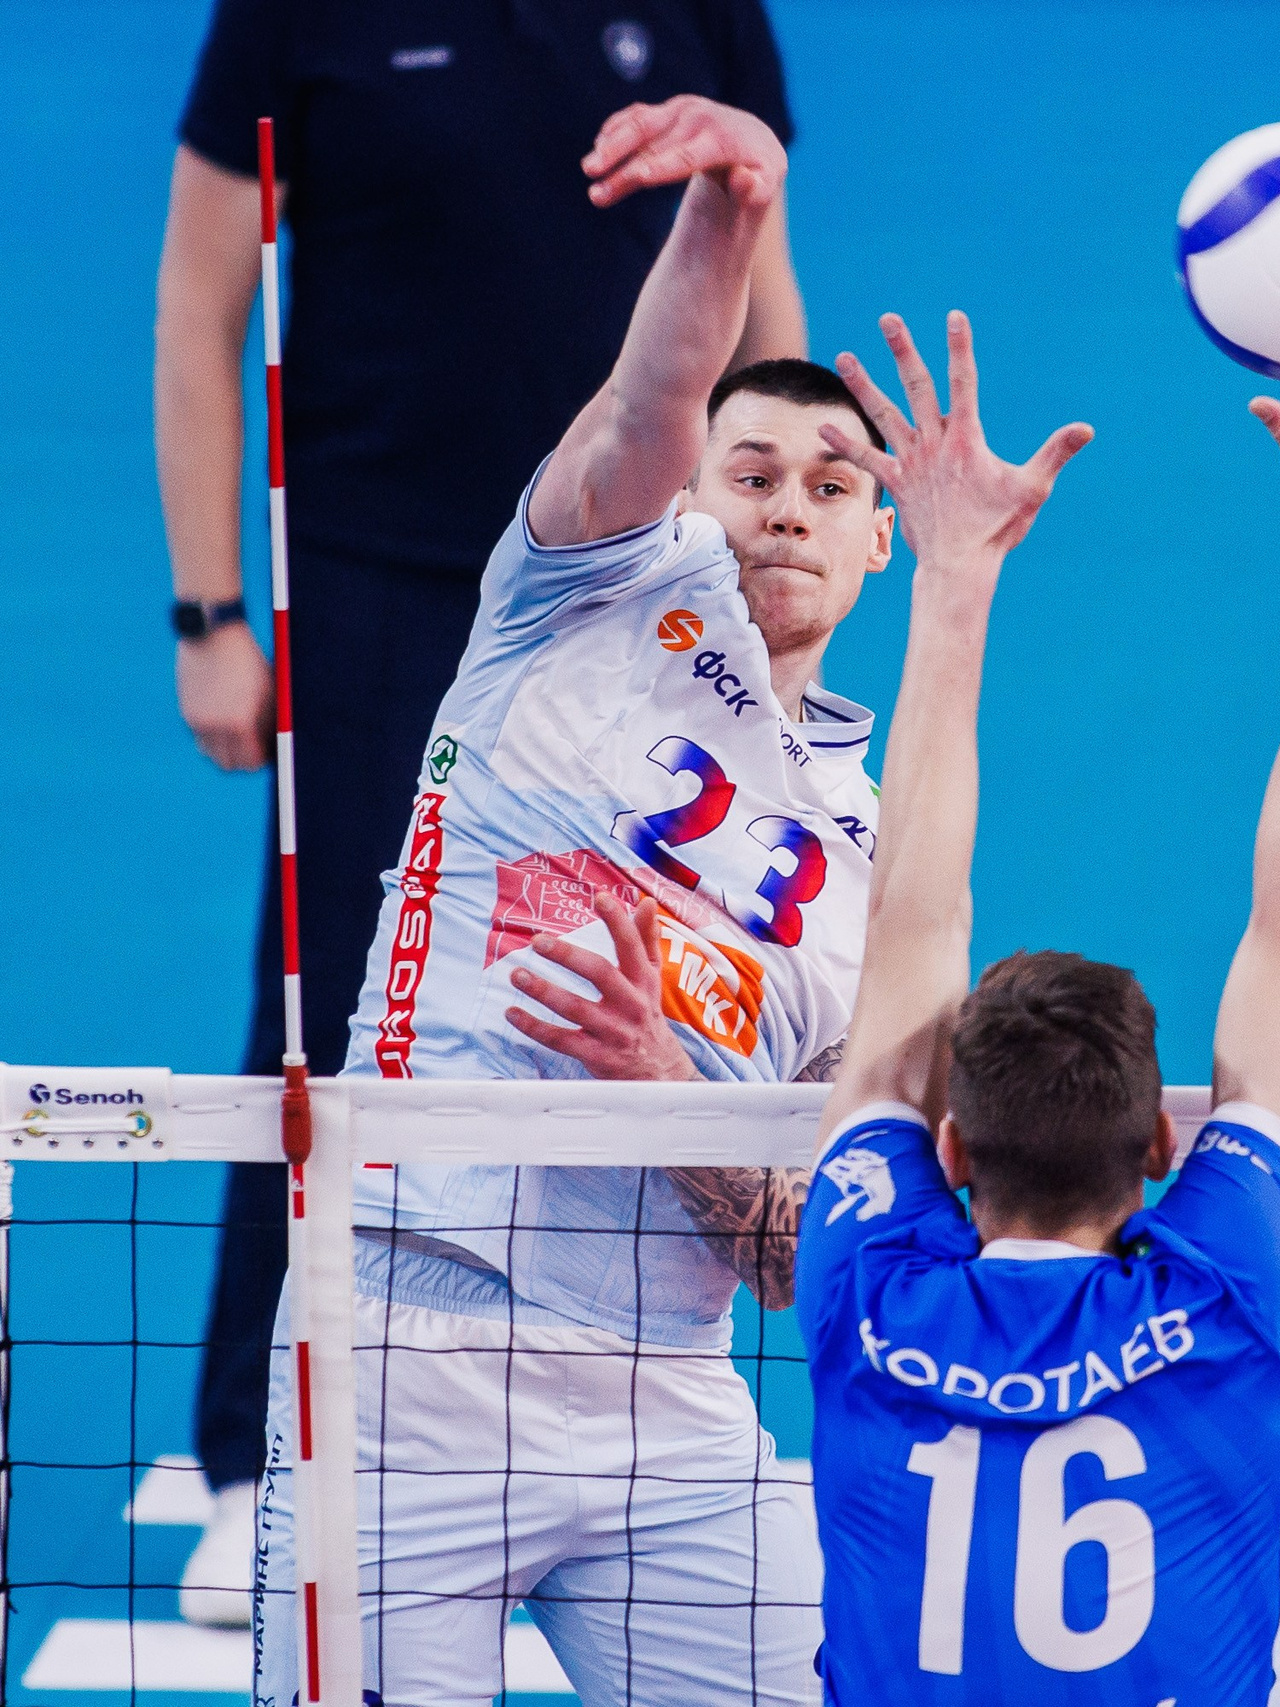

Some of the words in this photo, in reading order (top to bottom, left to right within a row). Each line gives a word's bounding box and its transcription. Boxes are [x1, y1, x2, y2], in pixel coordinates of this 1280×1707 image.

[692, 650, 759, 718] ФСК
[381, 796, 438, 1079] UROSPAR
[611, 735, 829, 948] 23
[55, 1088, 144, 1105] Senoh
[906, 1413, 1156, 1676] 16
